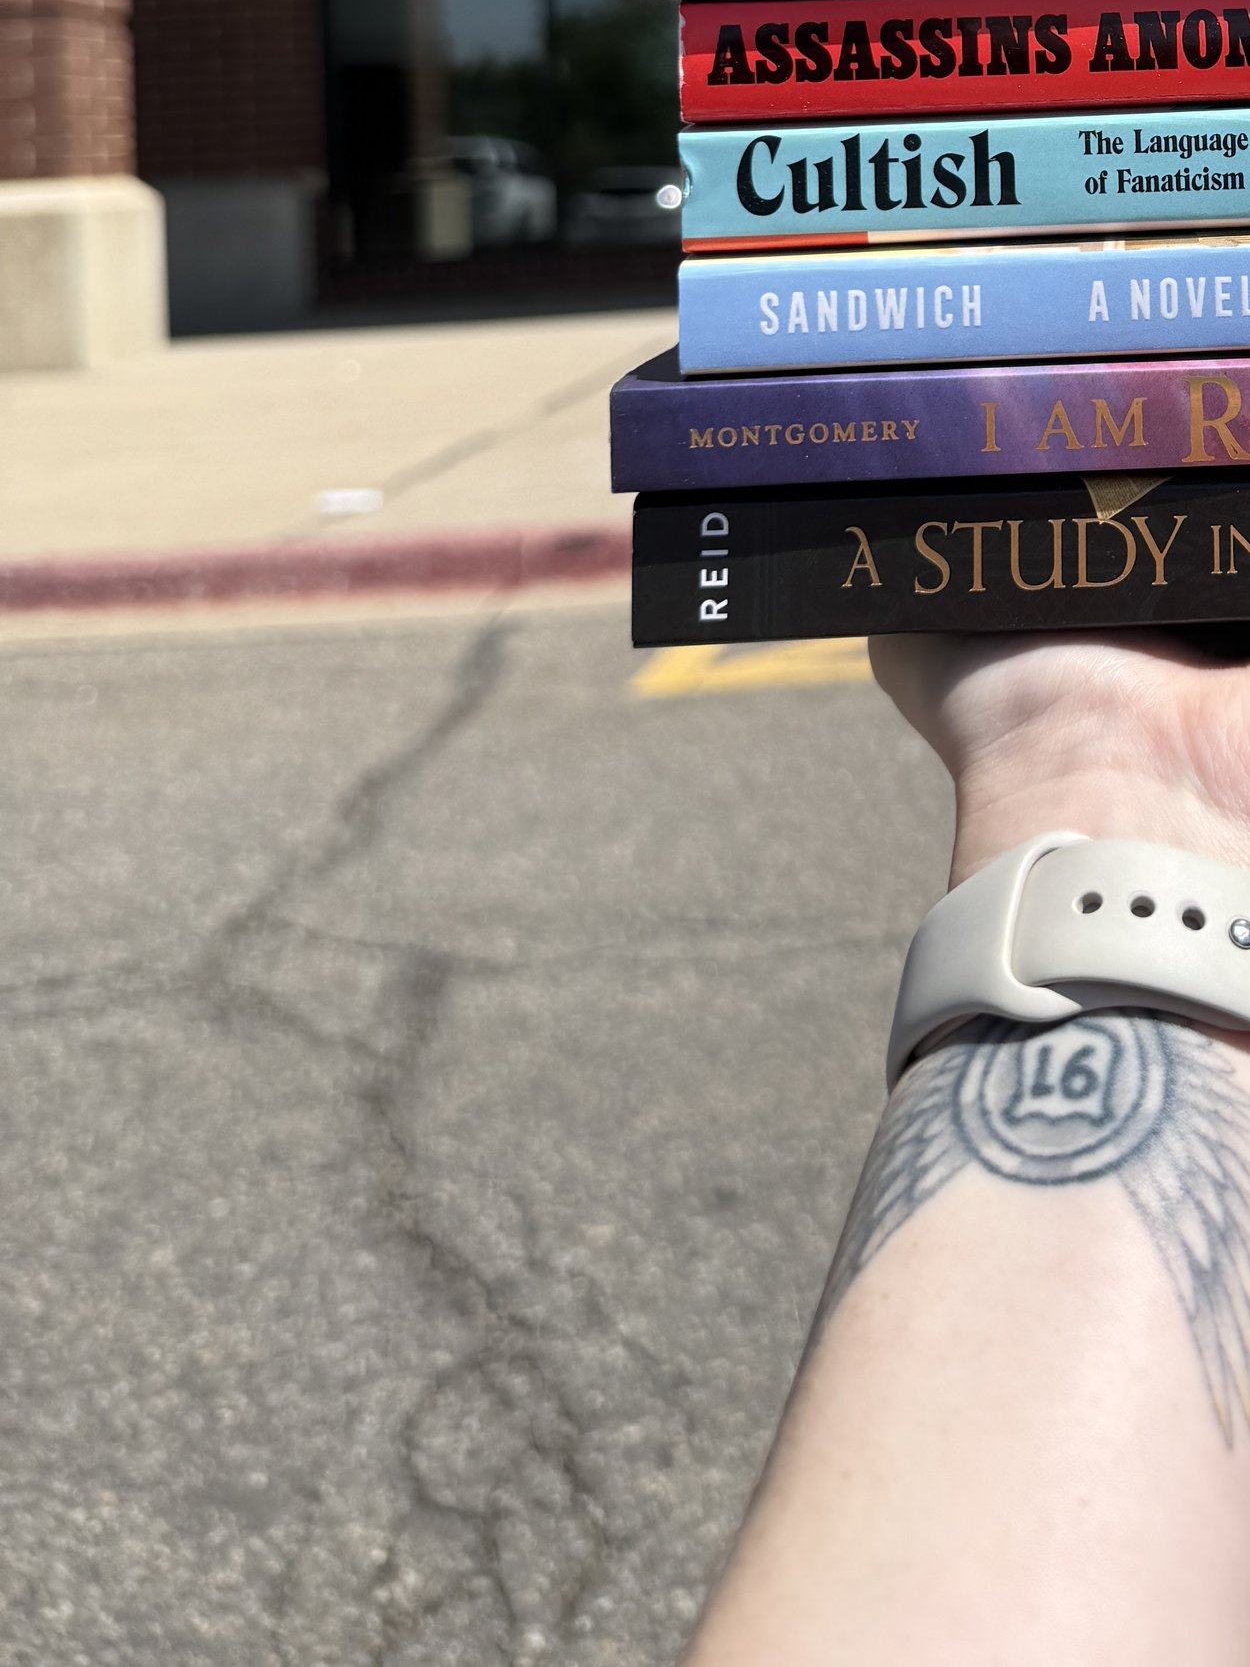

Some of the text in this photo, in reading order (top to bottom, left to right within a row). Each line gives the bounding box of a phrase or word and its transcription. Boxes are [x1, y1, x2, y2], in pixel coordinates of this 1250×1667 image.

[706, 13, 1073, 86] ASSASSINS
[1078, 128, 1249, 160] The Language
[736, 128, 1022, 217] Cultish
[1084, 166, 1245, 196] of Fanaticism
[759, 284, 982, 336] SANDWICH
[1087, 279, 1110, 323] A
[688, 418, 921, 449] MONTGOMERY
[980, 402, 1003, 453] I
[1034, 396, 1148, 451] AM
[699, 510, 730, 622] REID
[841, 525, 883, 589] A
[913, 514, 1188, 595] STUDY
